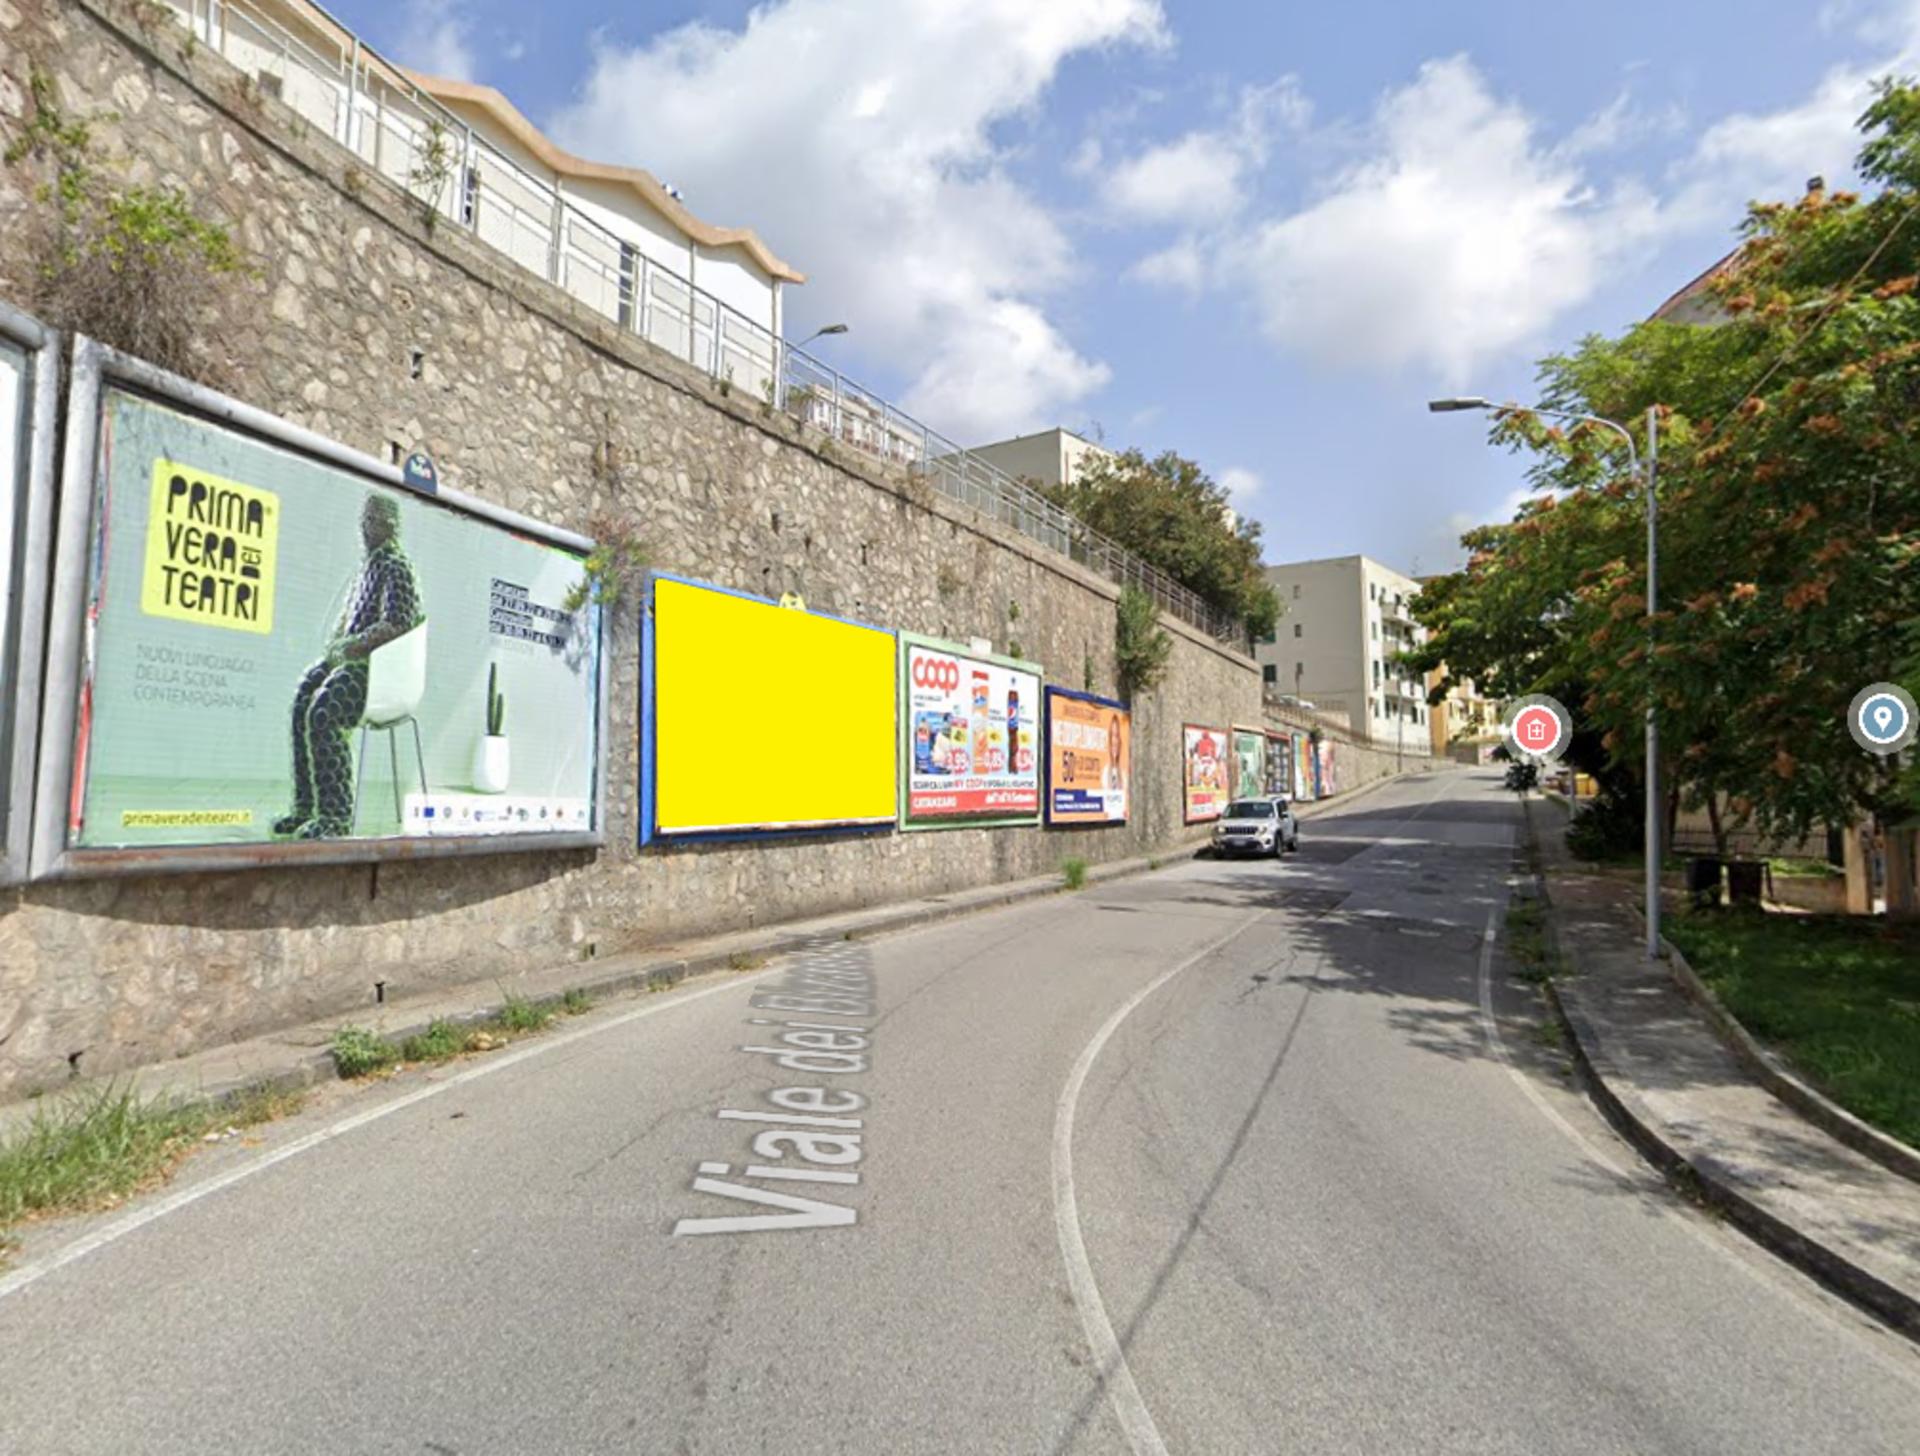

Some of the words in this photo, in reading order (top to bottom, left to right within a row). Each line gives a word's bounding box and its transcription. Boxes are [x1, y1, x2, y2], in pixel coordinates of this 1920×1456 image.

[166, 474, 263, 538] PRIMA
[165, 519, 237, 574] VERA
[161, 564, 259, 622] TEATRI
